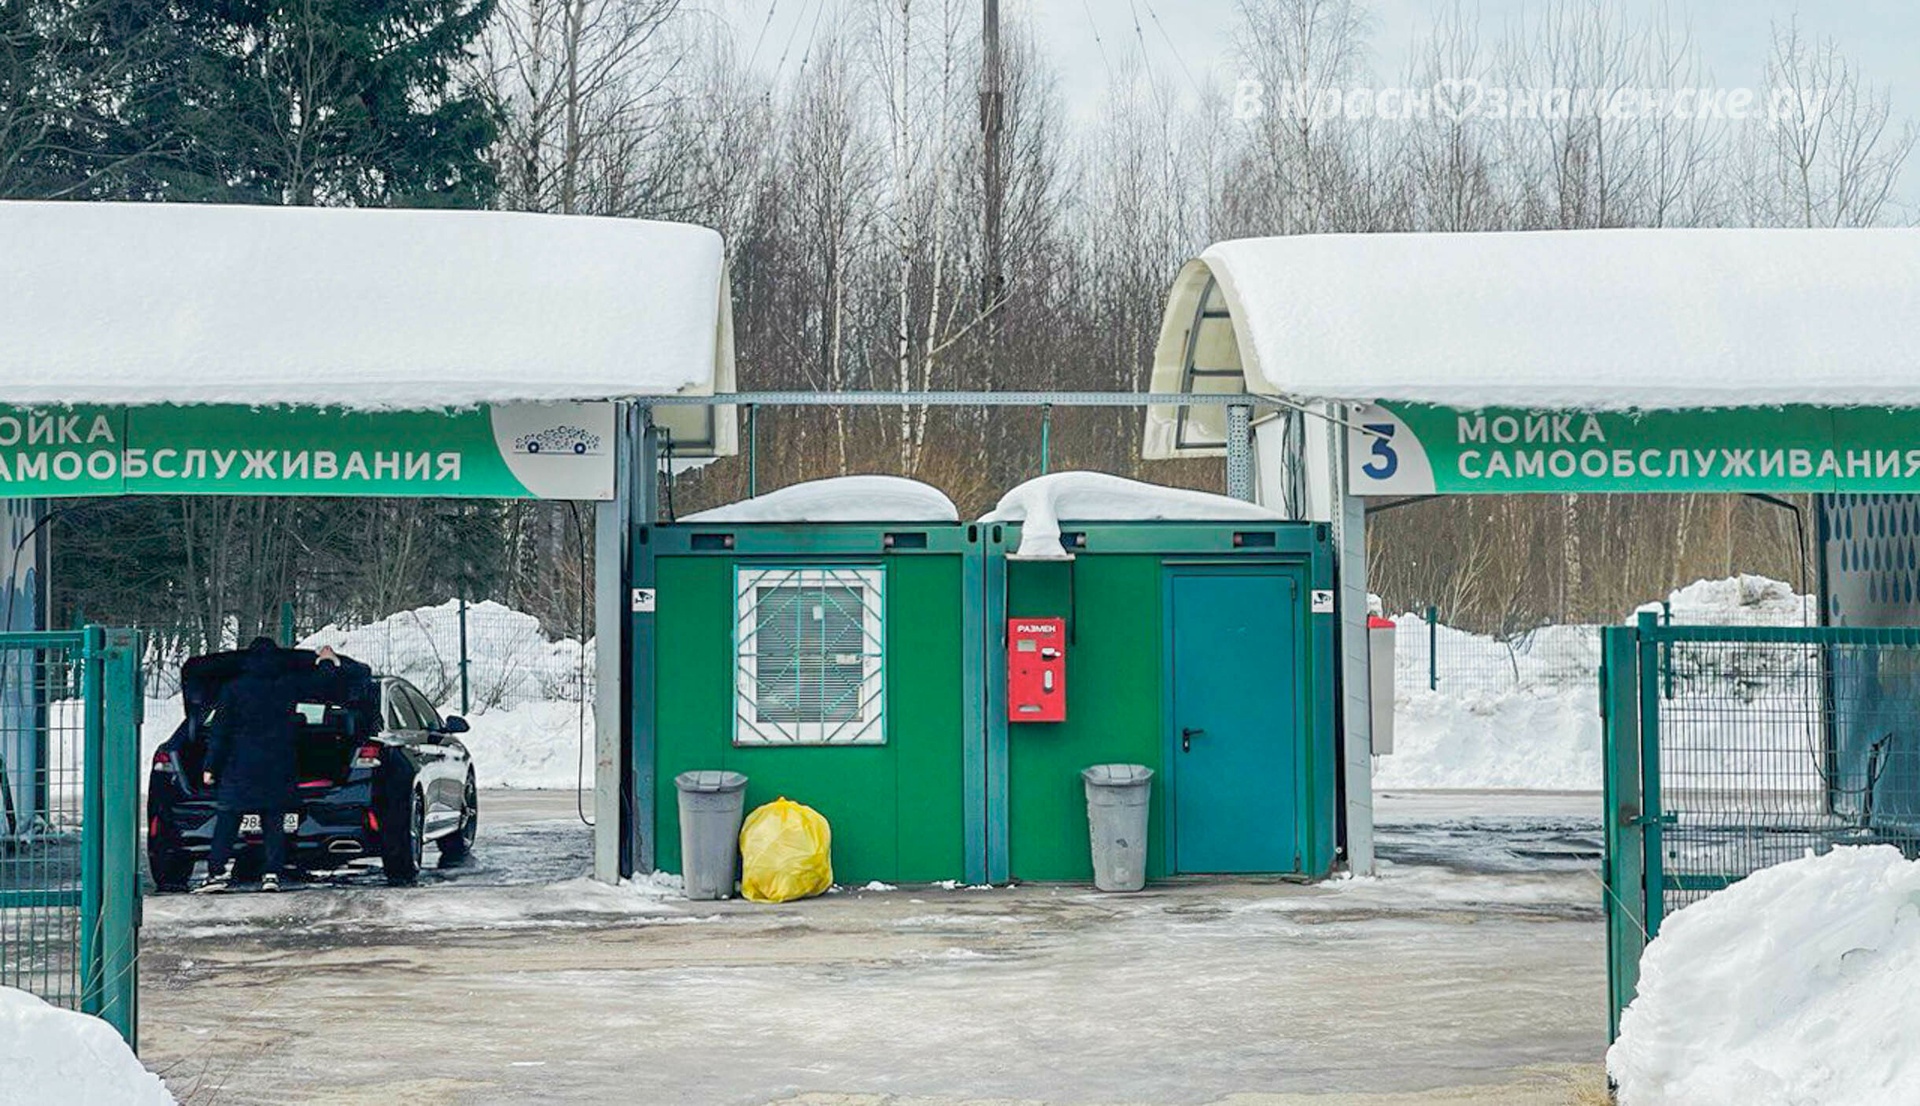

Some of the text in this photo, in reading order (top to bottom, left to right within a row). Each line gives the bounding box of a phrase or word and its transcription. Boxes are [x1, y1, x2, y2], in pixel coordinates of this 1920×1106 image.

[1457, 411, 1606, 444] МОЙКА
[1361, 423, 1398, 480] 3
[1017, 625, 1056, 633] РАЗМЕН
